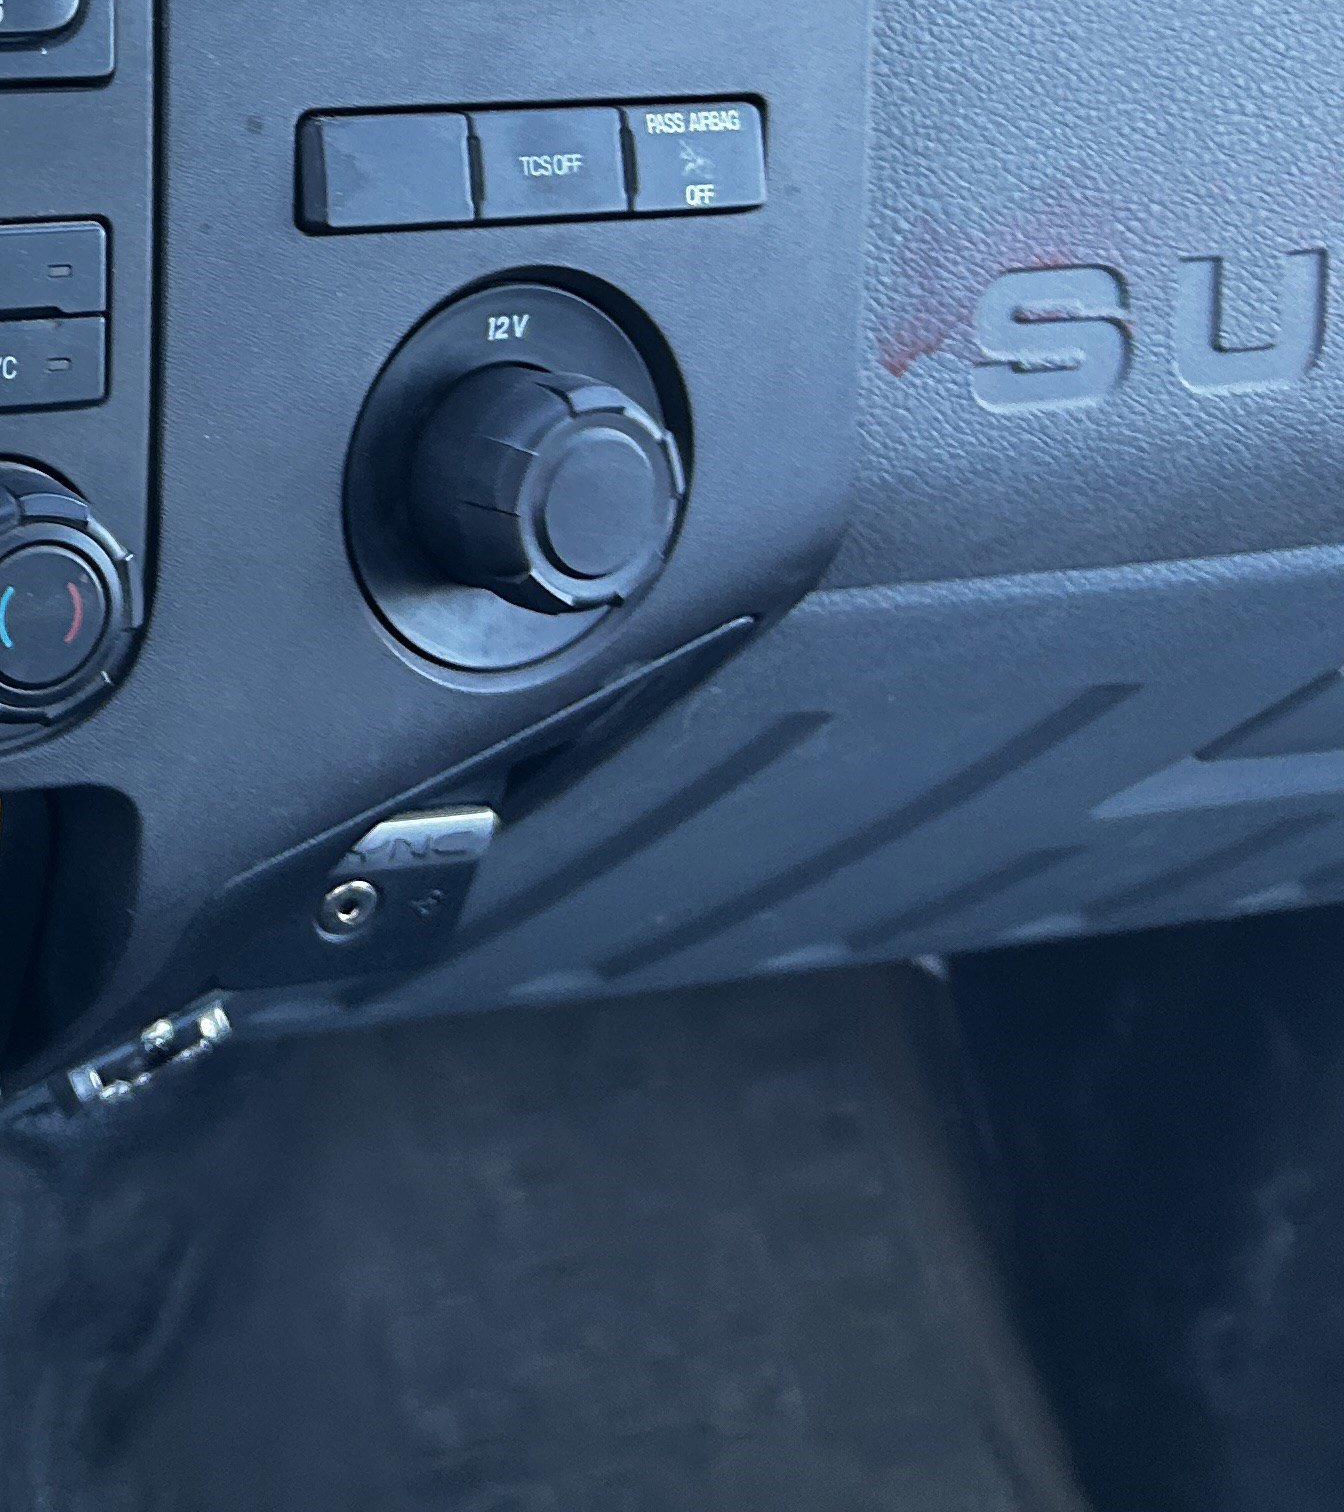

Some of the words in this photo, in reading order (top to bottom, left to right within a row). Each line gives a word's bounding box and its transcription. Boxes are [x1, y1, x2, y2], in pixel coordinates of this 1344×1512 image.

[645, 112, 686, 134] PASS
[689, 109, 741, 132] AIRBAG
[685, 183, 715, 206] OFF
[487, 314, 530, 340] 12V
